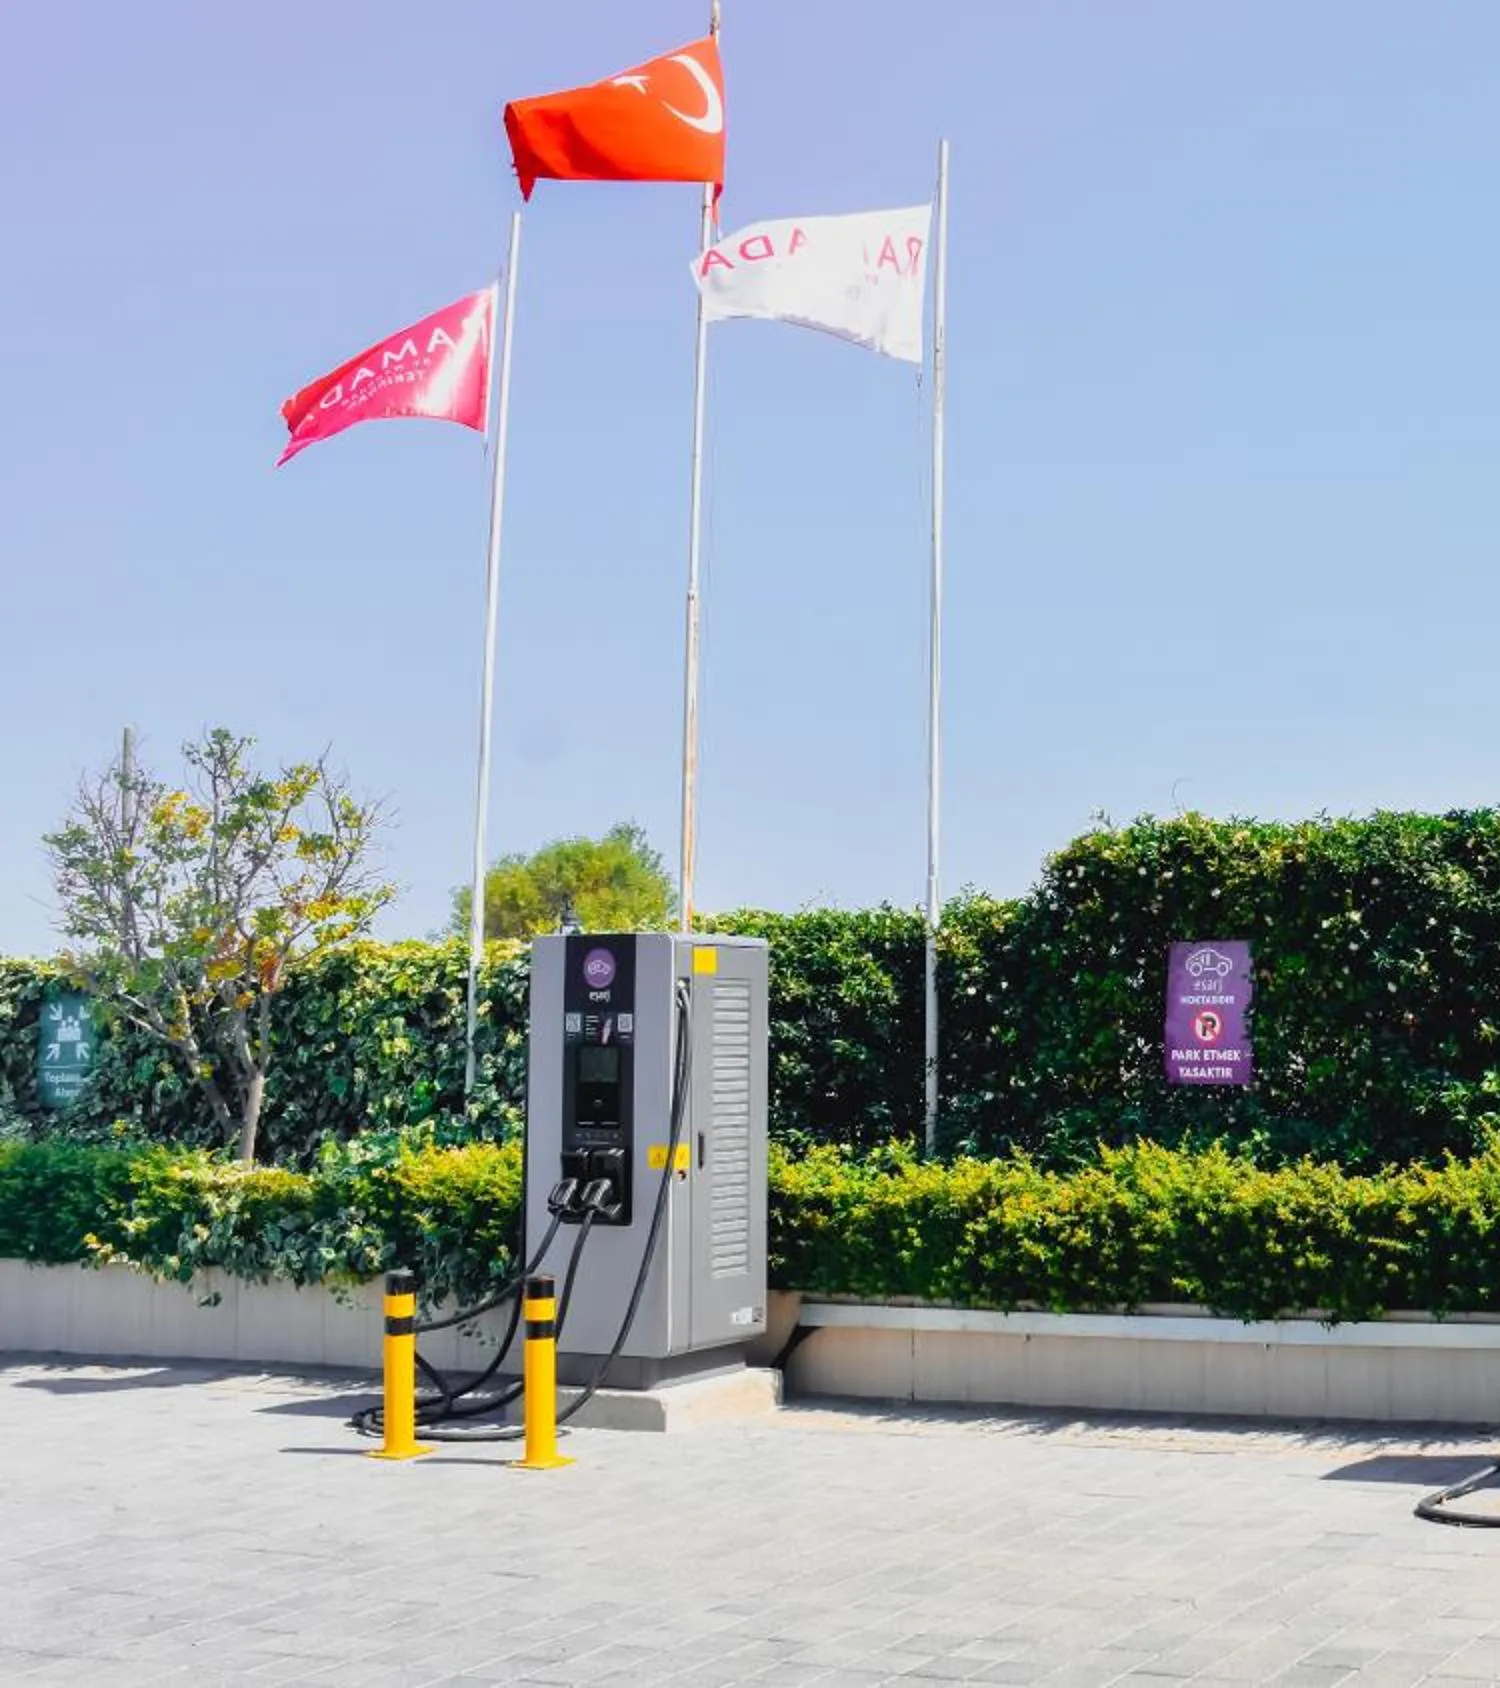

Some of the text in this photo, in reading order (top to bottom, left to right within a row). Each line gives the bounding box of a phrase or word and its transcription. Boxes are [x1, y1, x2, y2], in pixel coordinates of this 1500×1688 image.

[1171, 1049, 1241, 1061] PARK ETMEK
[1179, 1066, 1233, 1079] YASAKTIR
